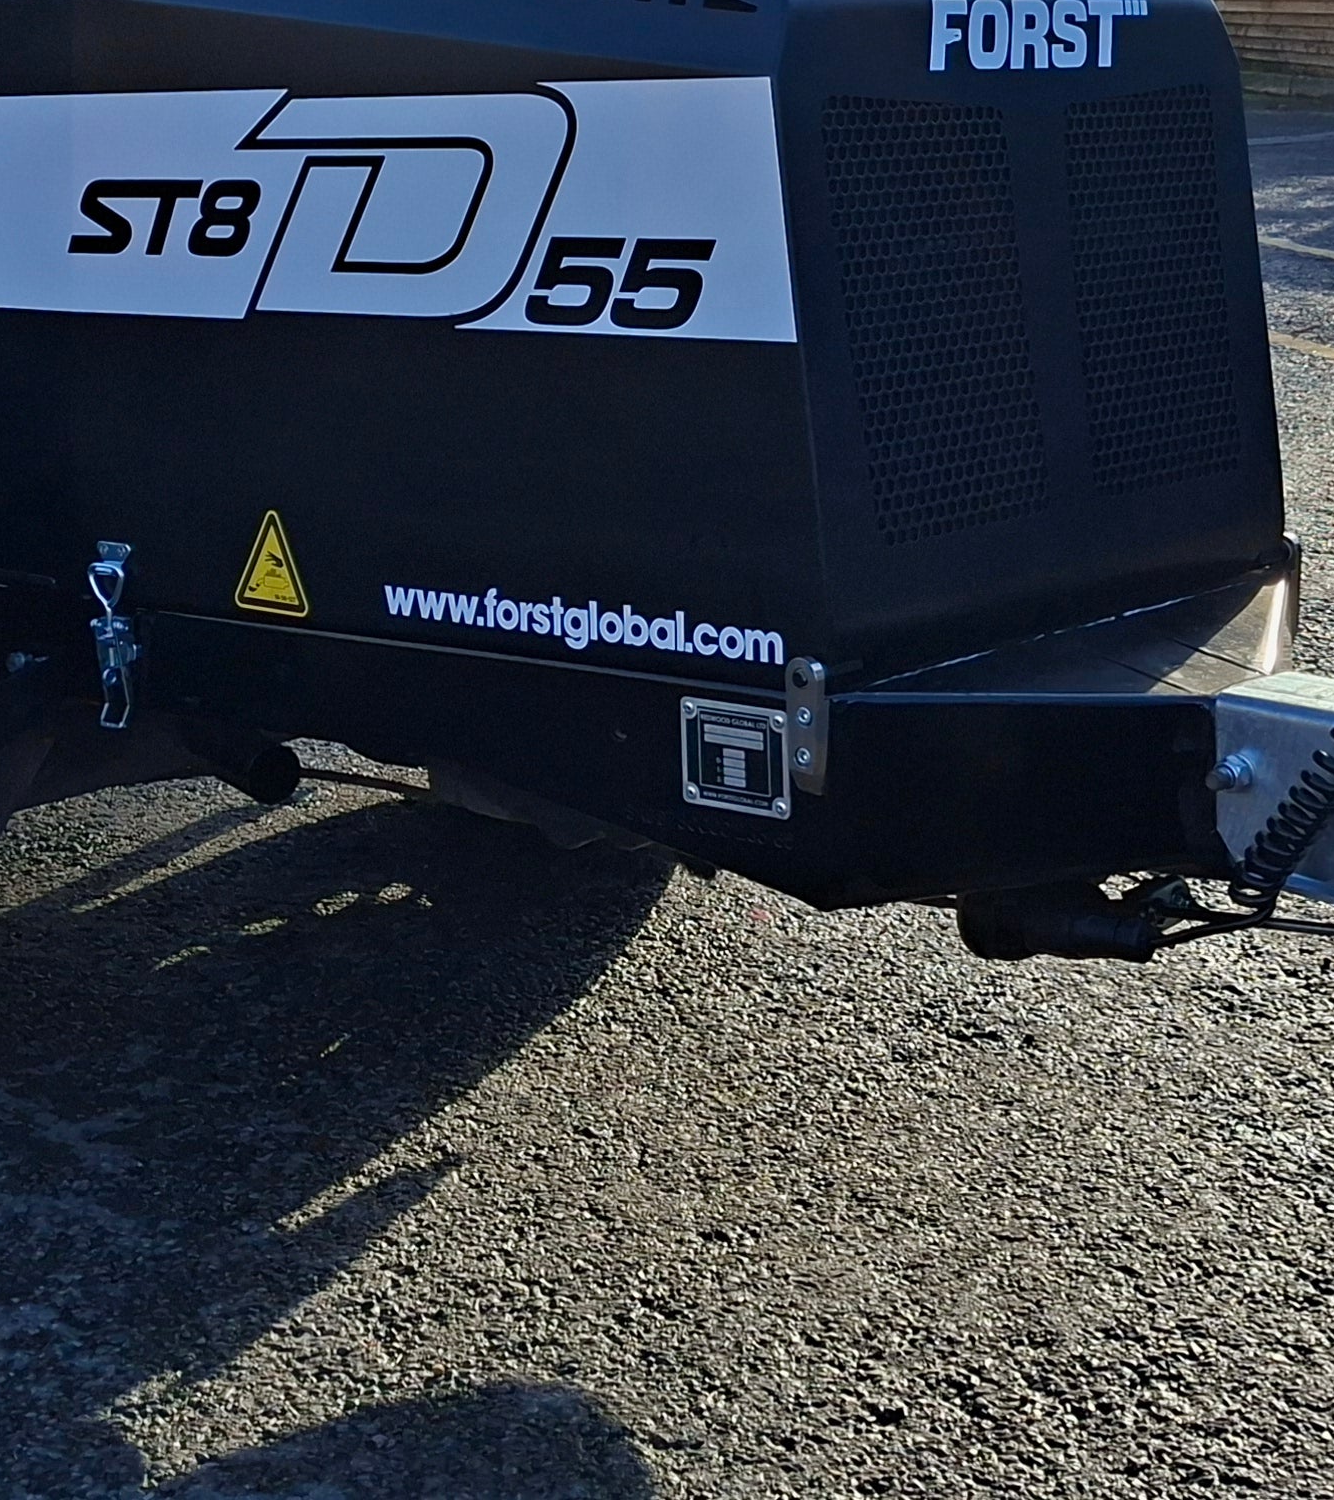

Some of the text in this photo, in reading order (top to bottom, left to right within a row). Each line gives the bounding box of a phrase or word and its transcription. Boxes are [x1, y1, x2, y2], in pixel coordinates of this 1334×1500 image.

[68, 178, 262, 258] ST8
[523, 236, 718, 330] 55
[384, 584, 784, 665] www.forstglobal.com
